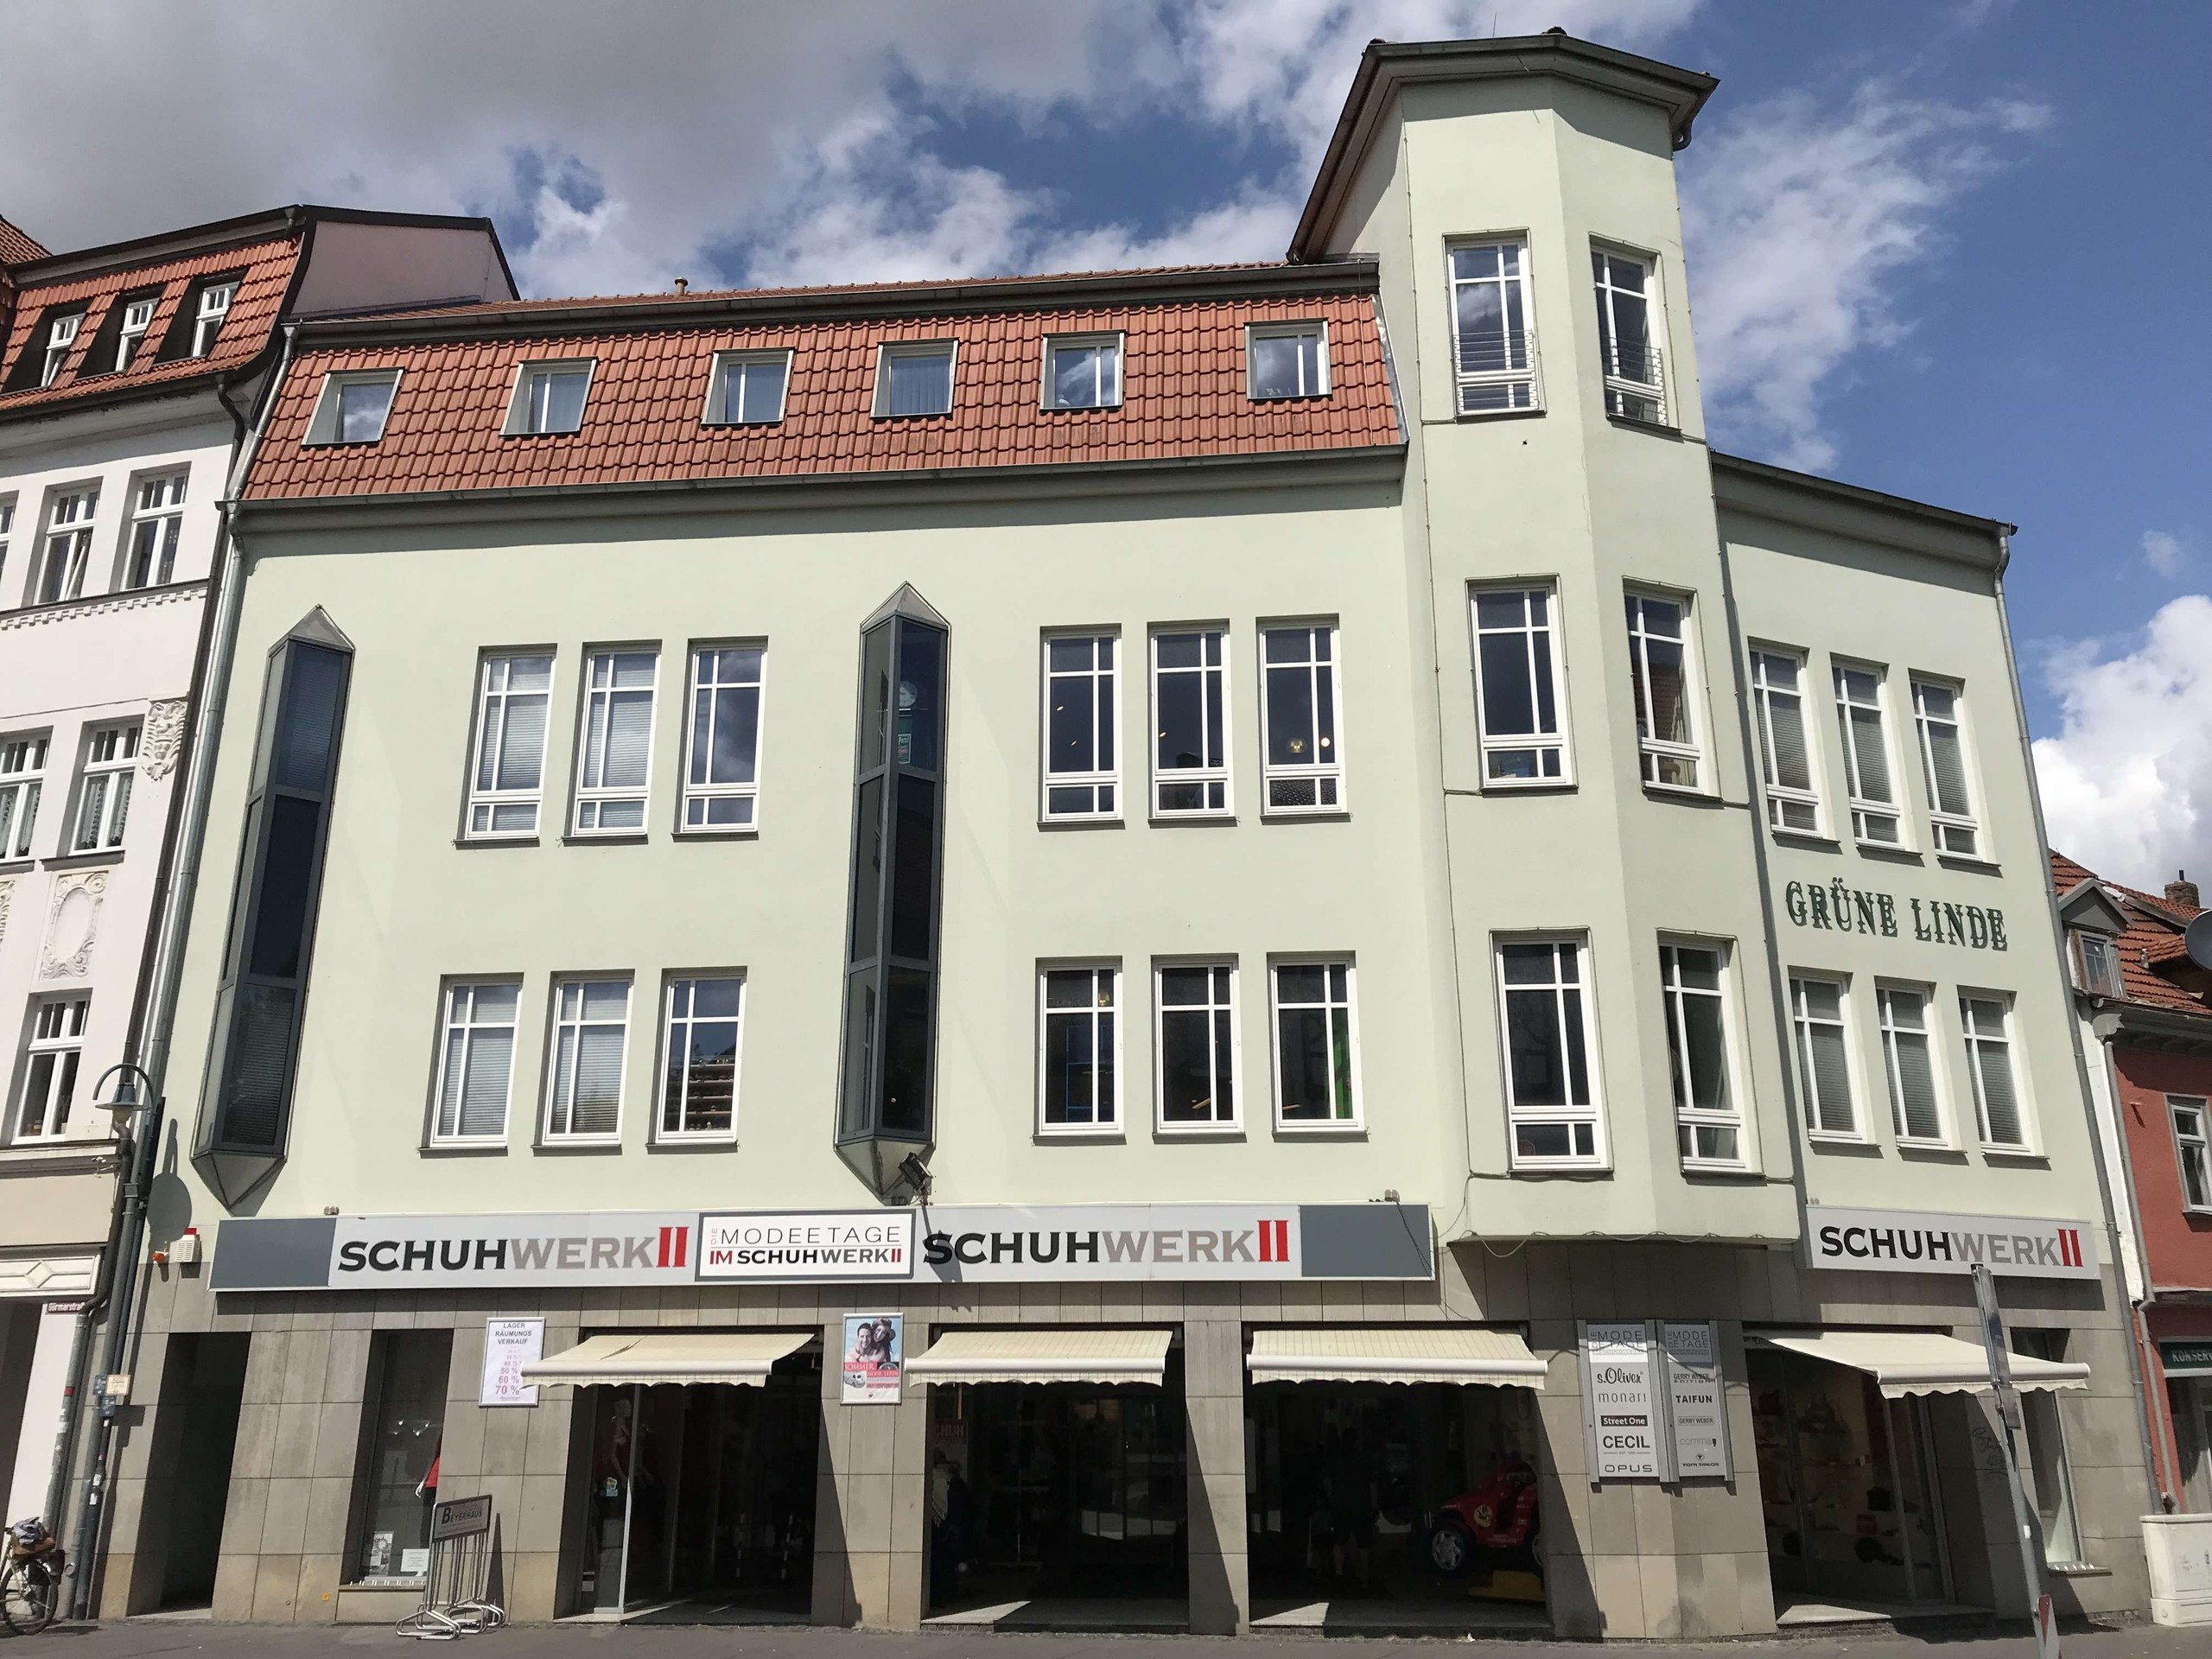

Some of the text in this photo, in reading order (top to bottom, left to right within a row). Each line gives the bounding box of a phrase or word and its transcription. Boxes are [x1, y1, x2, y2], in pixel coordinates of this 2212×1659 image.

[1786, 877, 2008, 951] GRÜNE LINDE
[709, 1250, 733, 1265] IM
[48, 1302, 85, 1311] Görmarstra
[1598, 1332, 1643, 1340] MODE
[1673, 1332, 1707, 1340] MODE
[495, 1385, 519, 1395] 70 %
[1599, 1392, 1646, 1402] monari
[1603, 1435, 1650, 1448] CECIL
